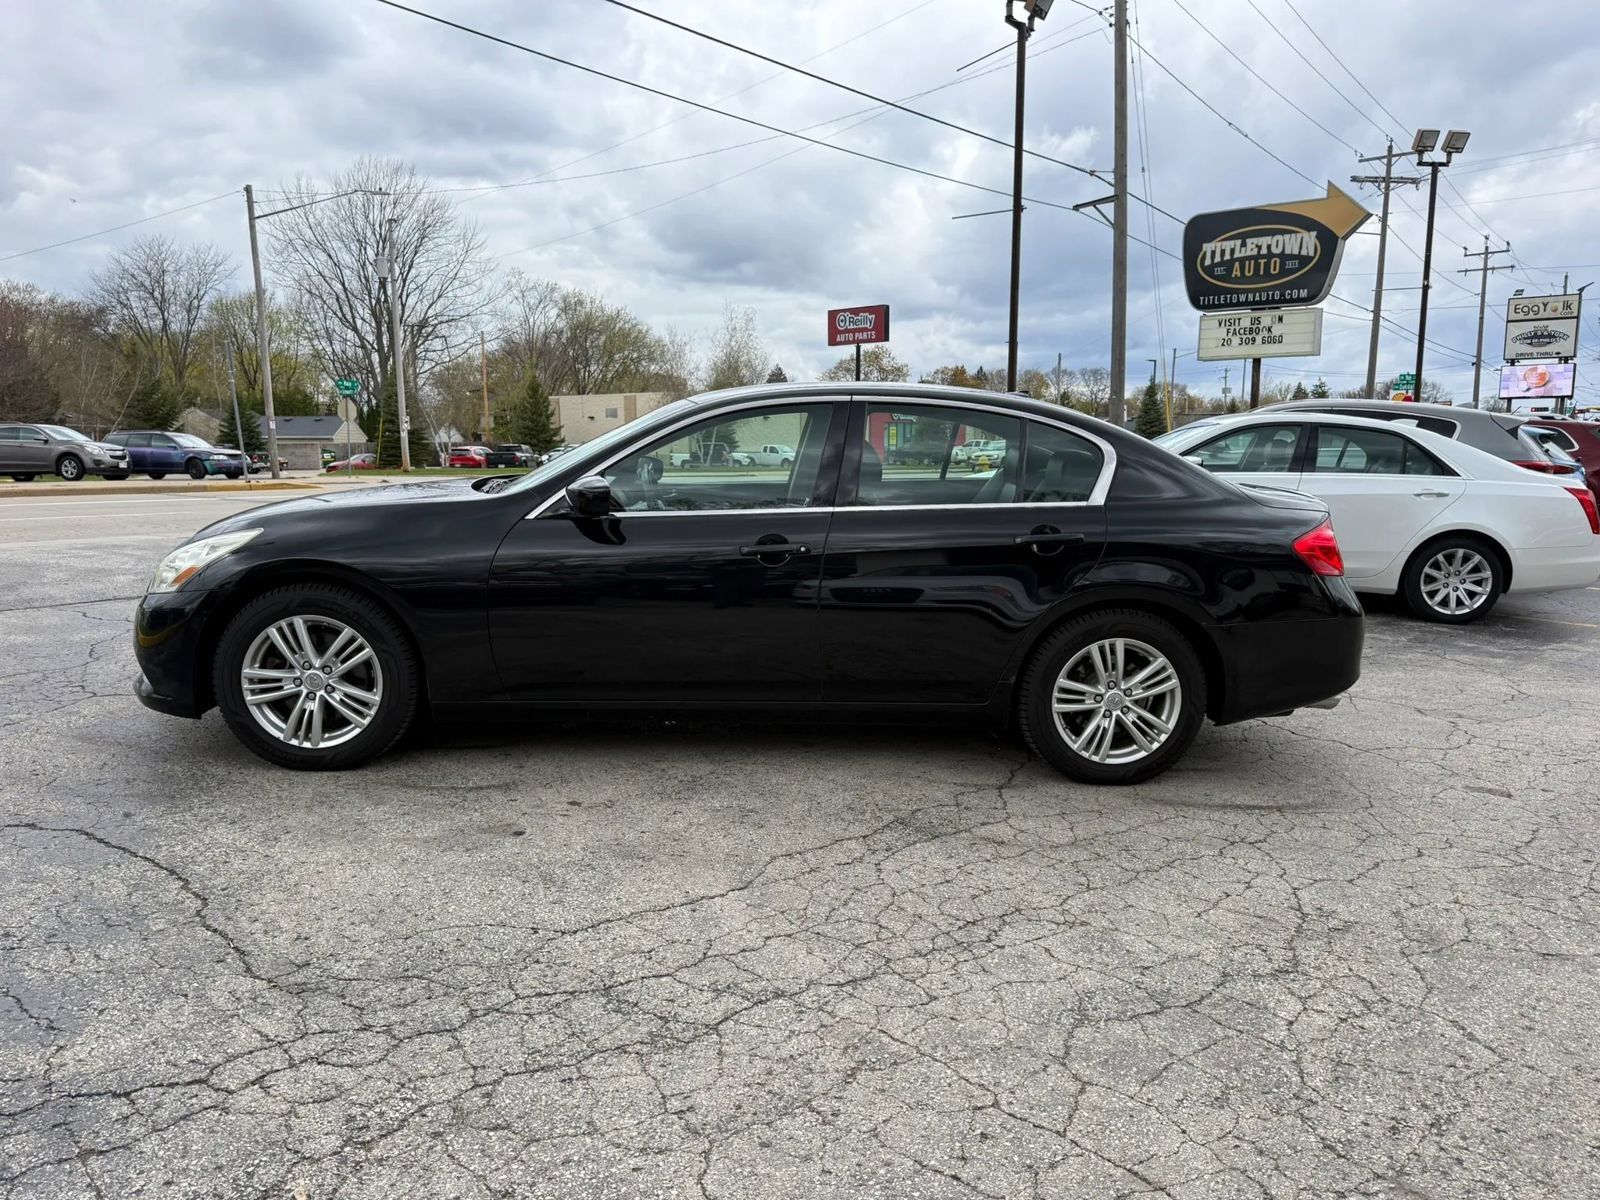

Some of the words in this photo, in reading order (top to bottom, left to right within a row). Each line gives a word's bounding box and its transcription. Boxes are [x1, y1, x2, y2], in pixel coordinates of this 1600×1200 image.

[1202, 230, 1318, 267] TITLETOWN
[1232, 257, 1280, 278] AUTO
[1199, 289, 1308, 305] TITLETOWNAUTO.COM
[836, 312, 875, 330] O'Reilly
[1218, 317, 1242, 327] VISIT
[1250, 316, 1262, 326] US
[836, 333, 854, 342] AUTO
[855, 331, 876, 340] PARTS
[1238, 336, 1256, 346] 309
[1261, 335, 1284, 344] 6060
